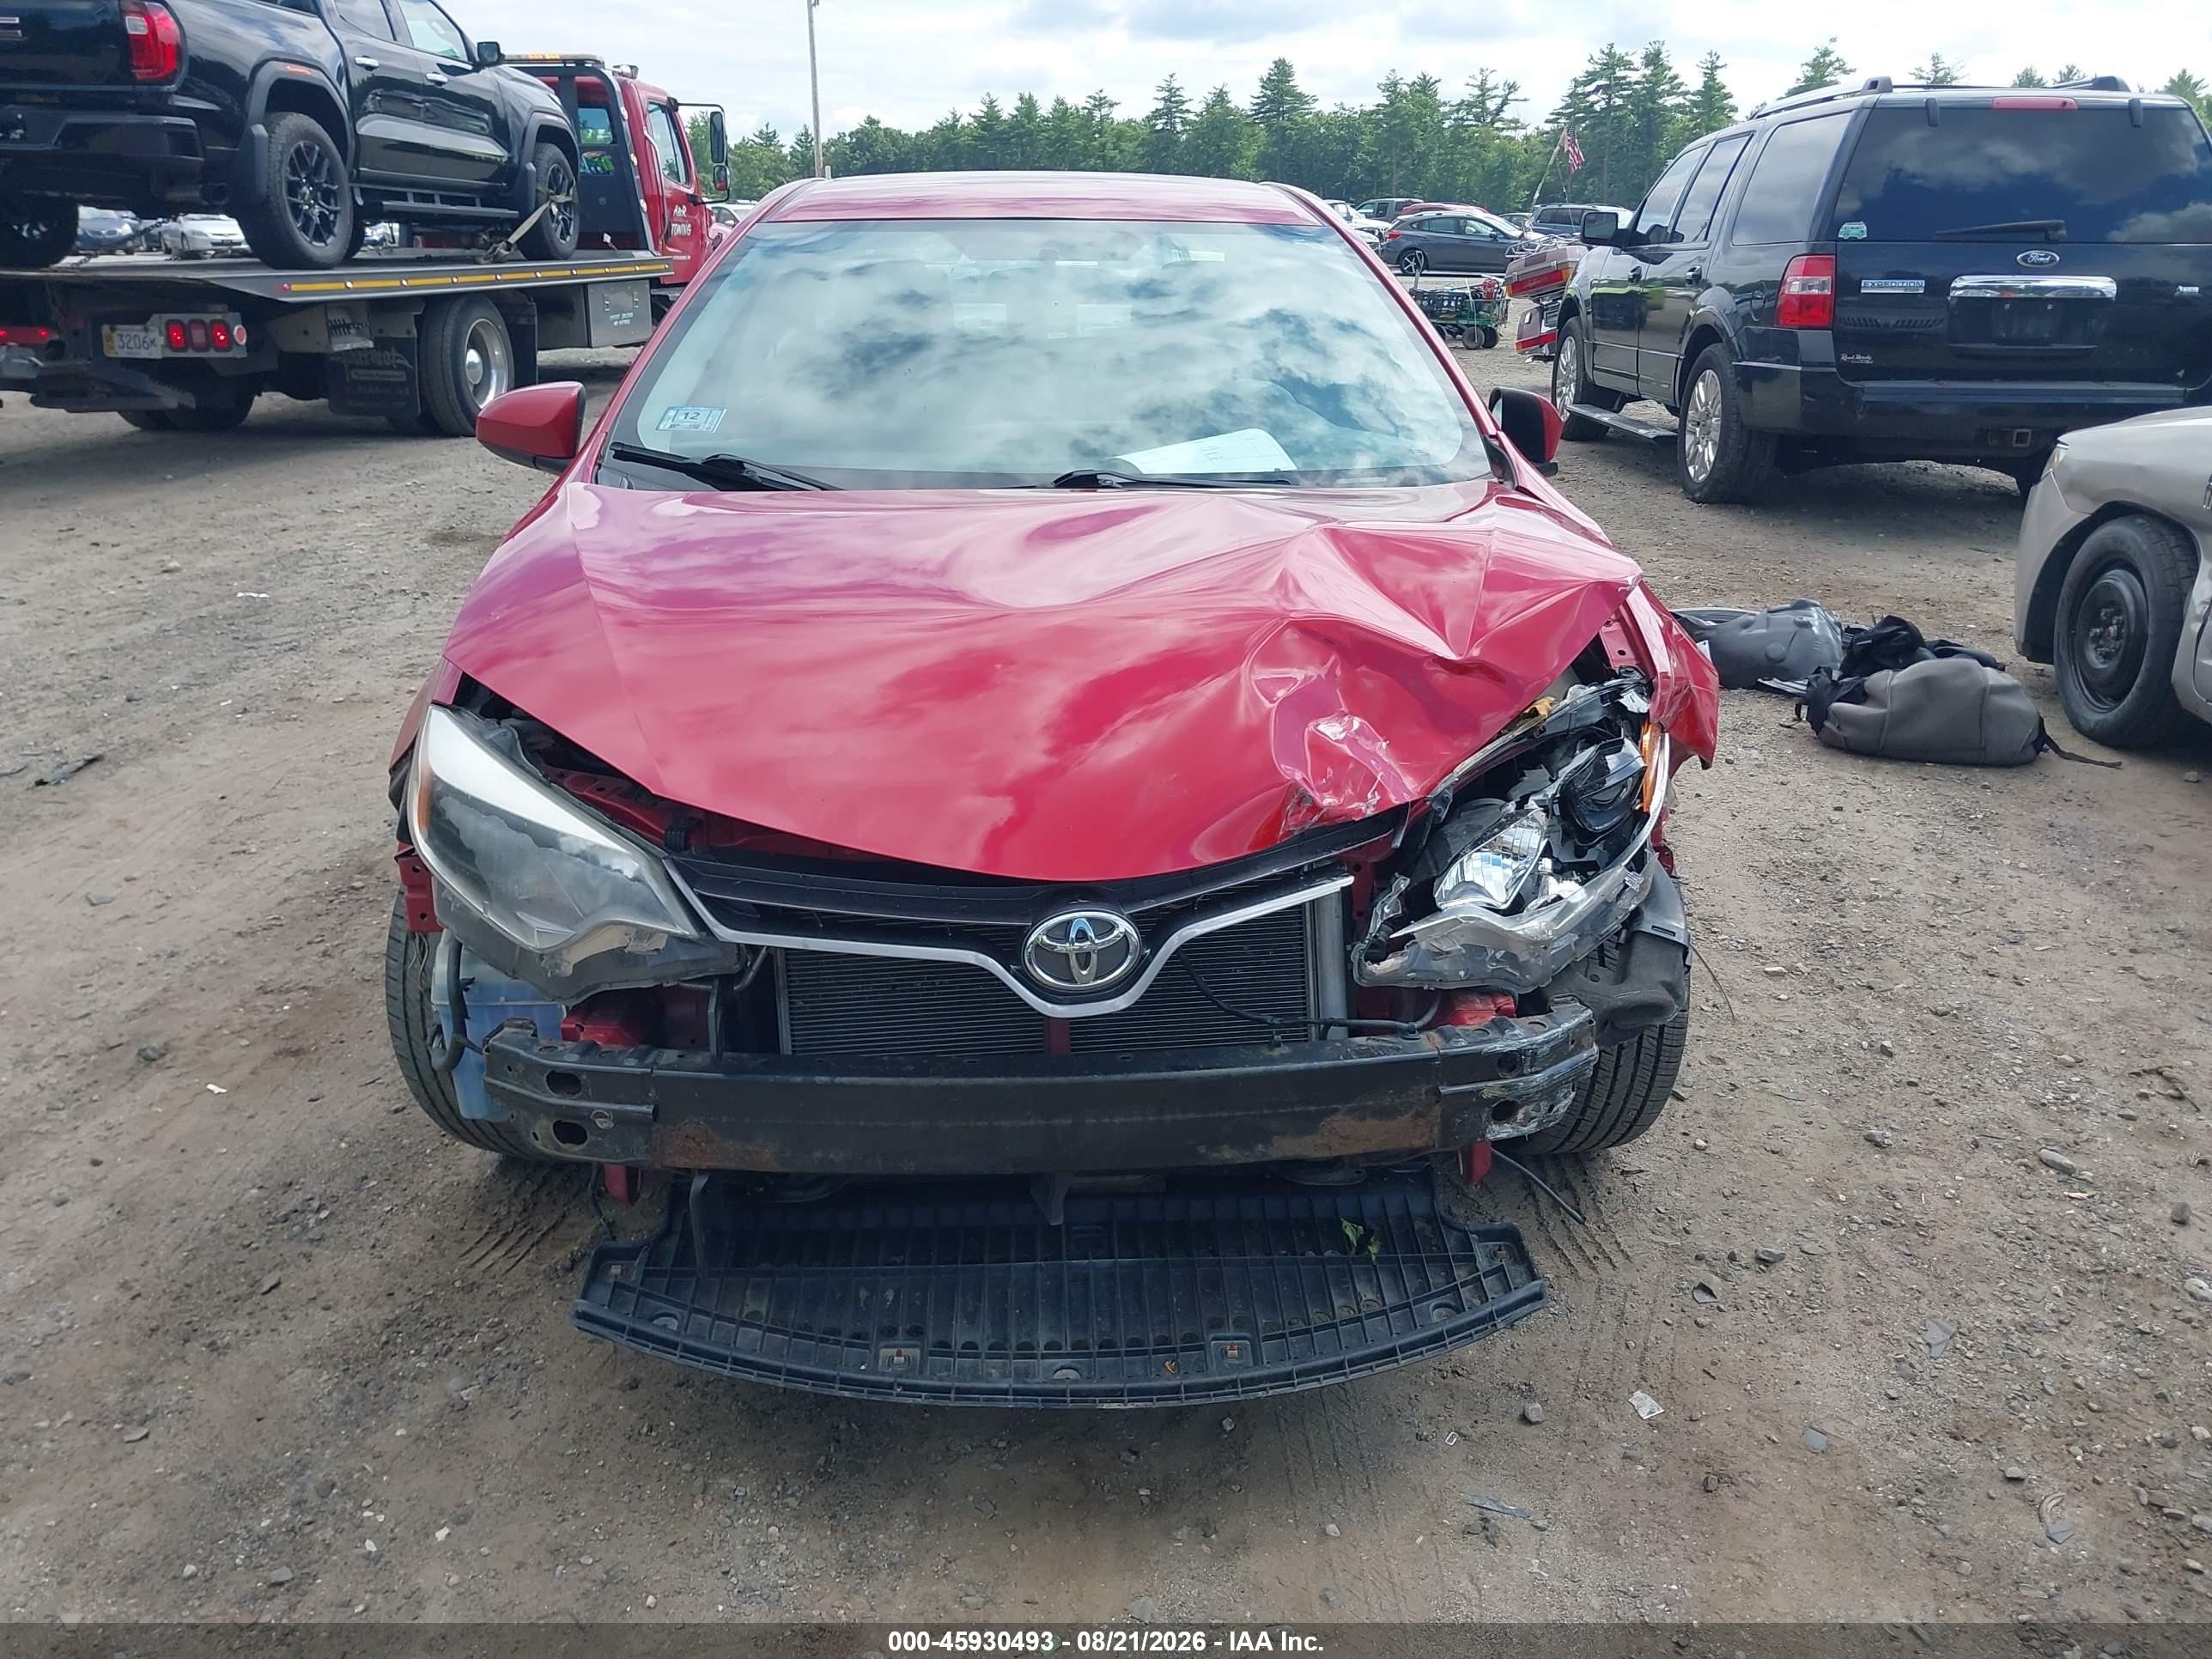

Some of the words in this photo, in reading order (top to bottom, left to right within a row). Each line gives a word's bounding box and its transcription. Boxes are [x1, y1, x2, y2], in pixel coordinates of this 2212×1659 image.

[672, 223, 691, 236] TOWING
[2027, 252, 2051, 263] Ford
[683, 411, 701, 420] 12
